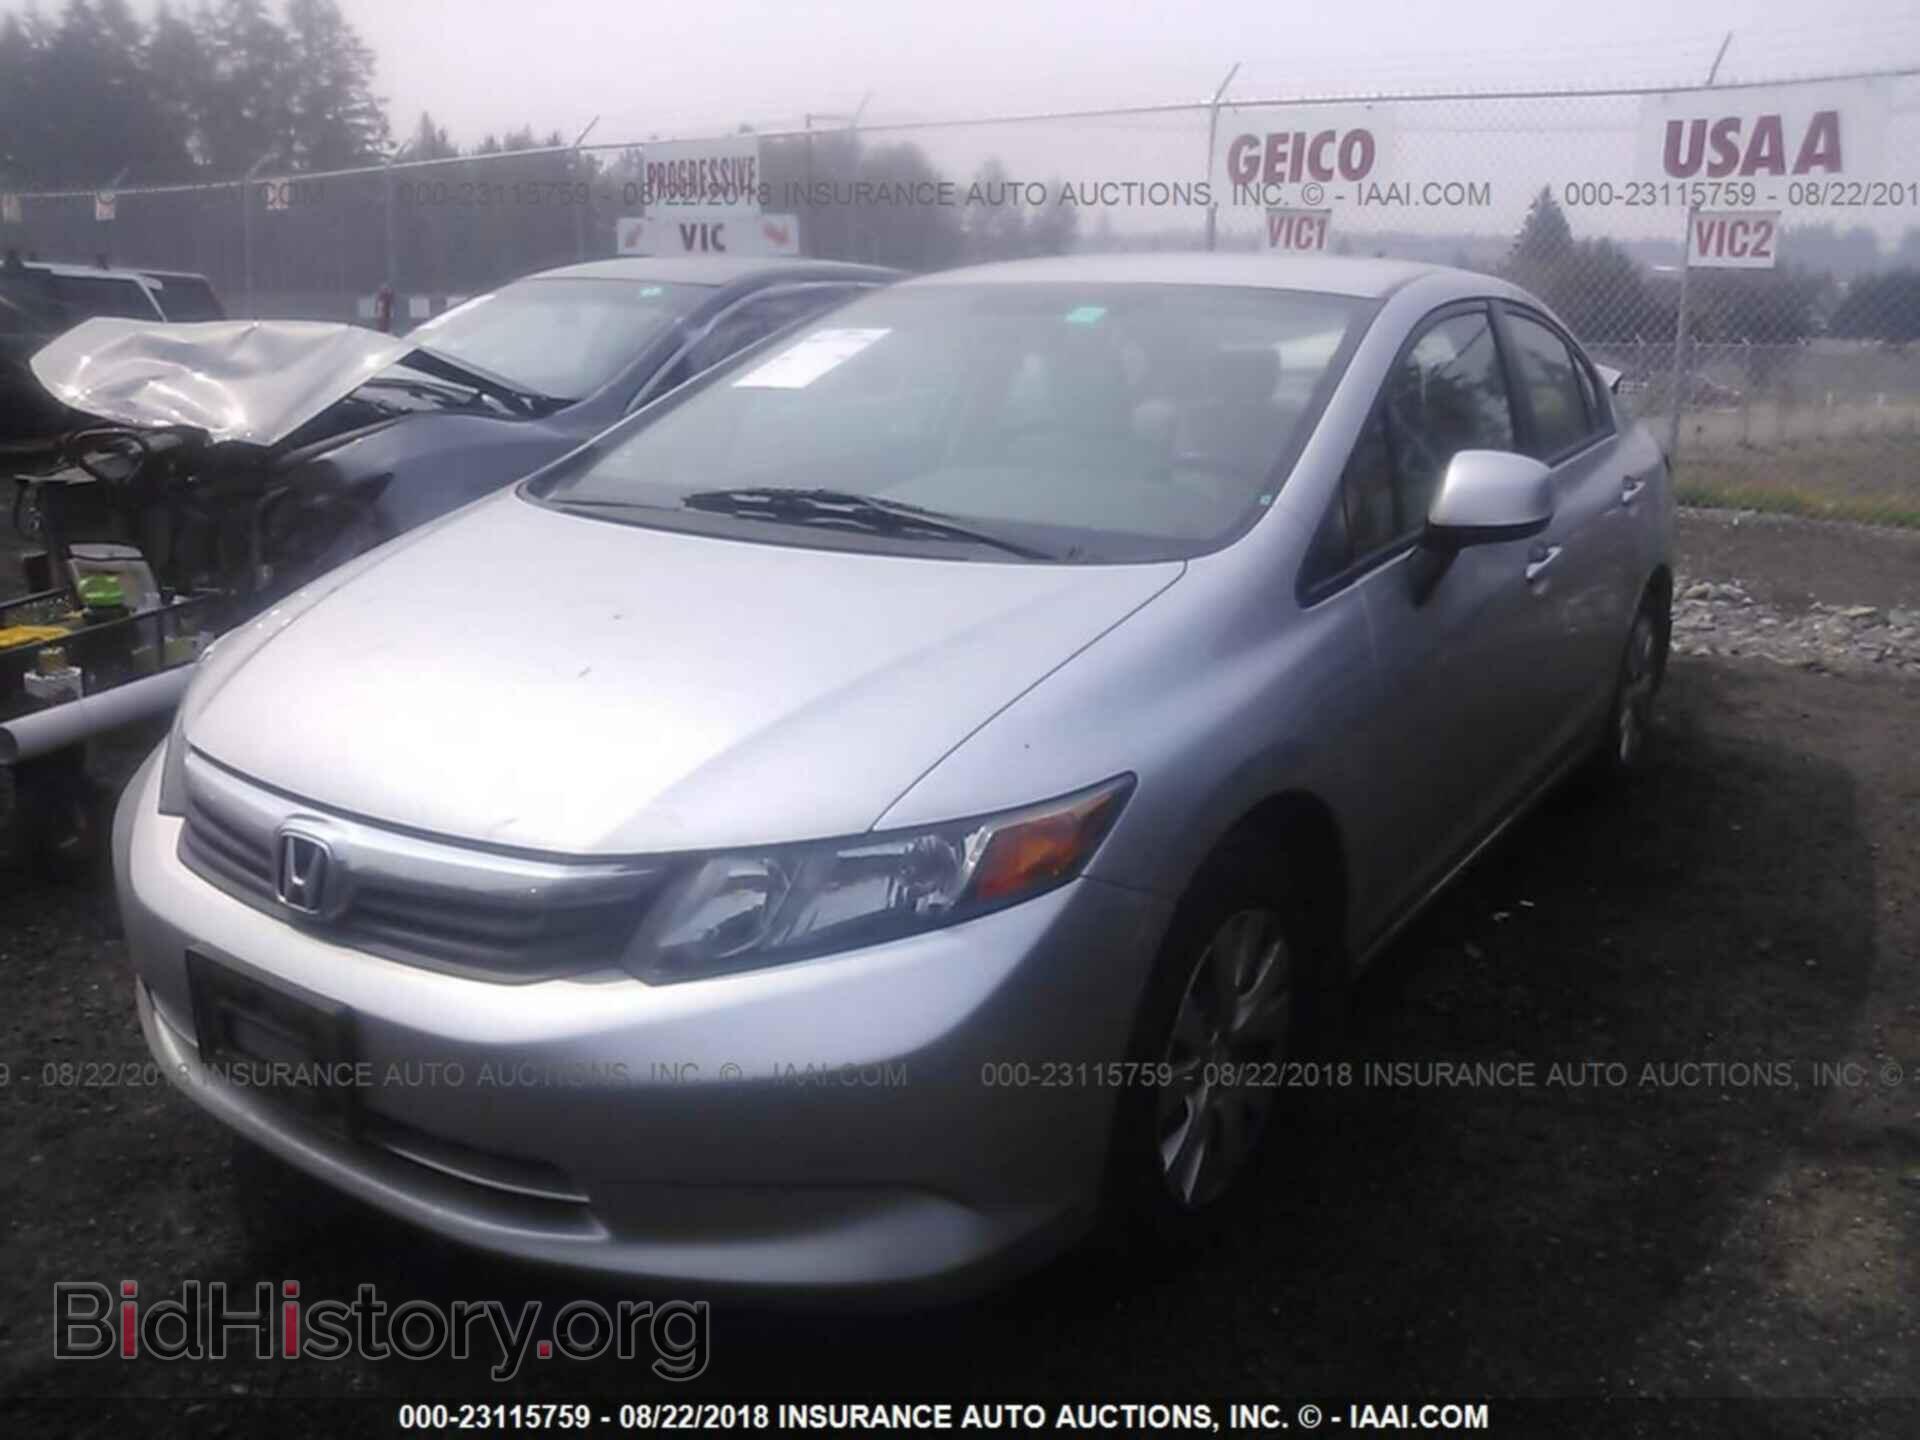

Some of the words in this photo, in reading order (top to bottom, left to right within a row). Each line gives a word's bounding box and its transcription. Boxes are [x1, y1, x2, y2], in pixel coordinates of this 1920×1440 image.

[1227, 128, 1376, 186] GEICO
[1662, 110, 1843, 179] USAA
[646, 156, 757, 199] PROGRESSIVE
[679, 223, 727, 253] VIC
[1267, 215, 1328, 250] VIC1
[1695, 218, 1775, 258] VIC2
